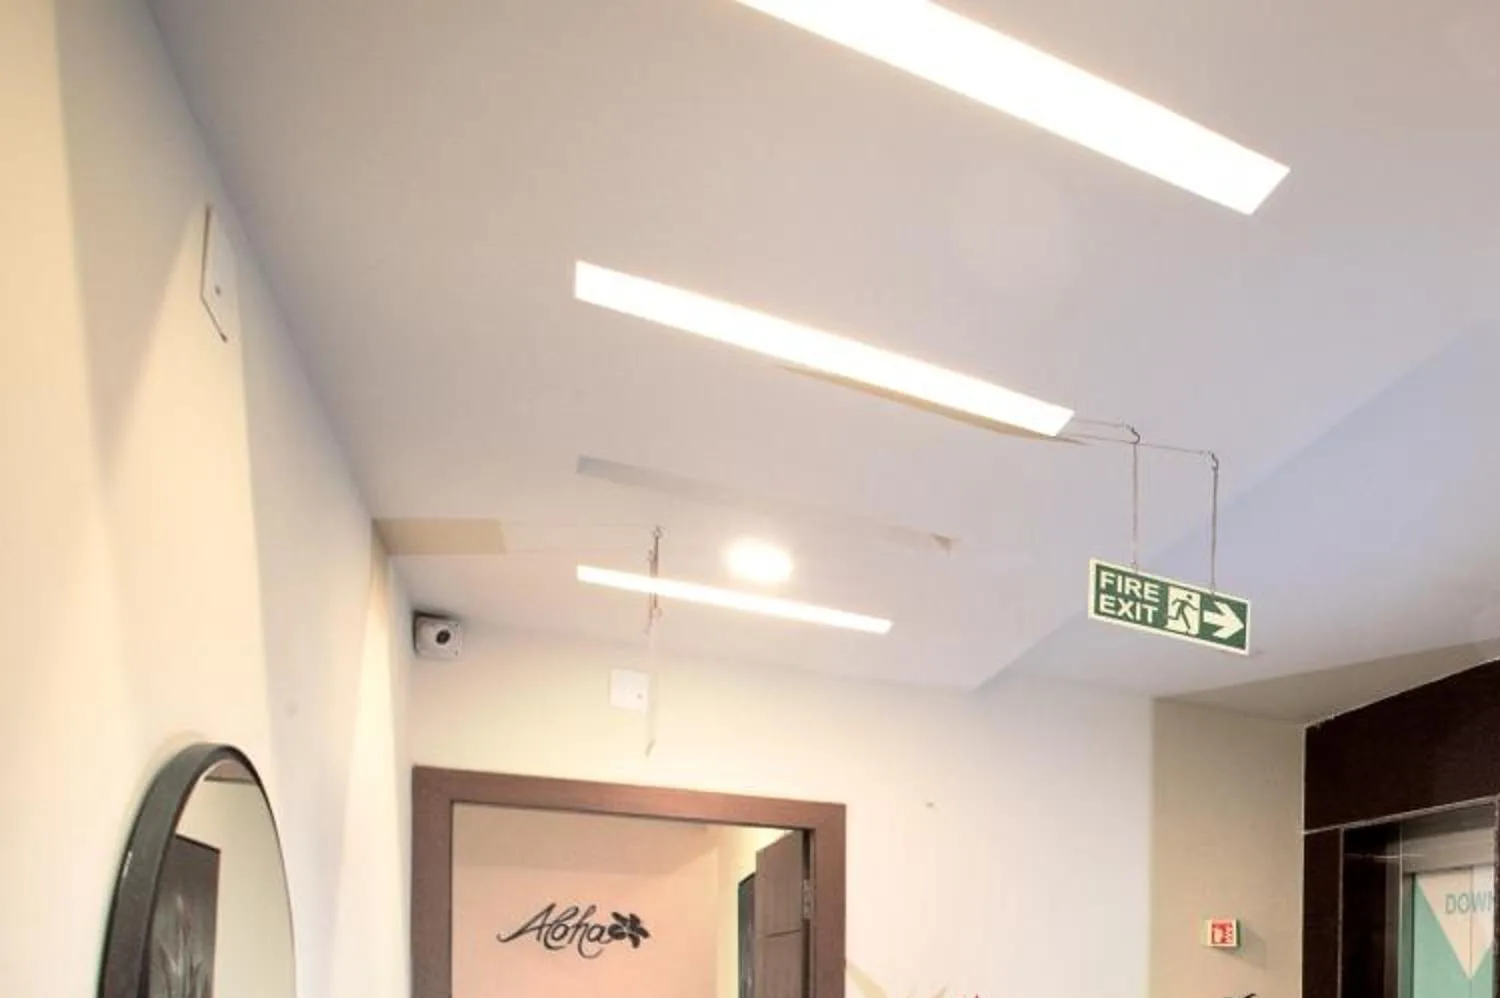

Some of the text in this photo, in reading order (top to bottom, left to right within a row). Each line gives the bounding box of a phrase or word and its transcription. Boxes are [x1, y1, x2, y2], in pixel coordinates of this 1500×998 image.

[1100, 571, 1161, 603] FIRE
[1100, 594, 1159, 624] EXIT
[496, 903, 613, 959] Aloha
